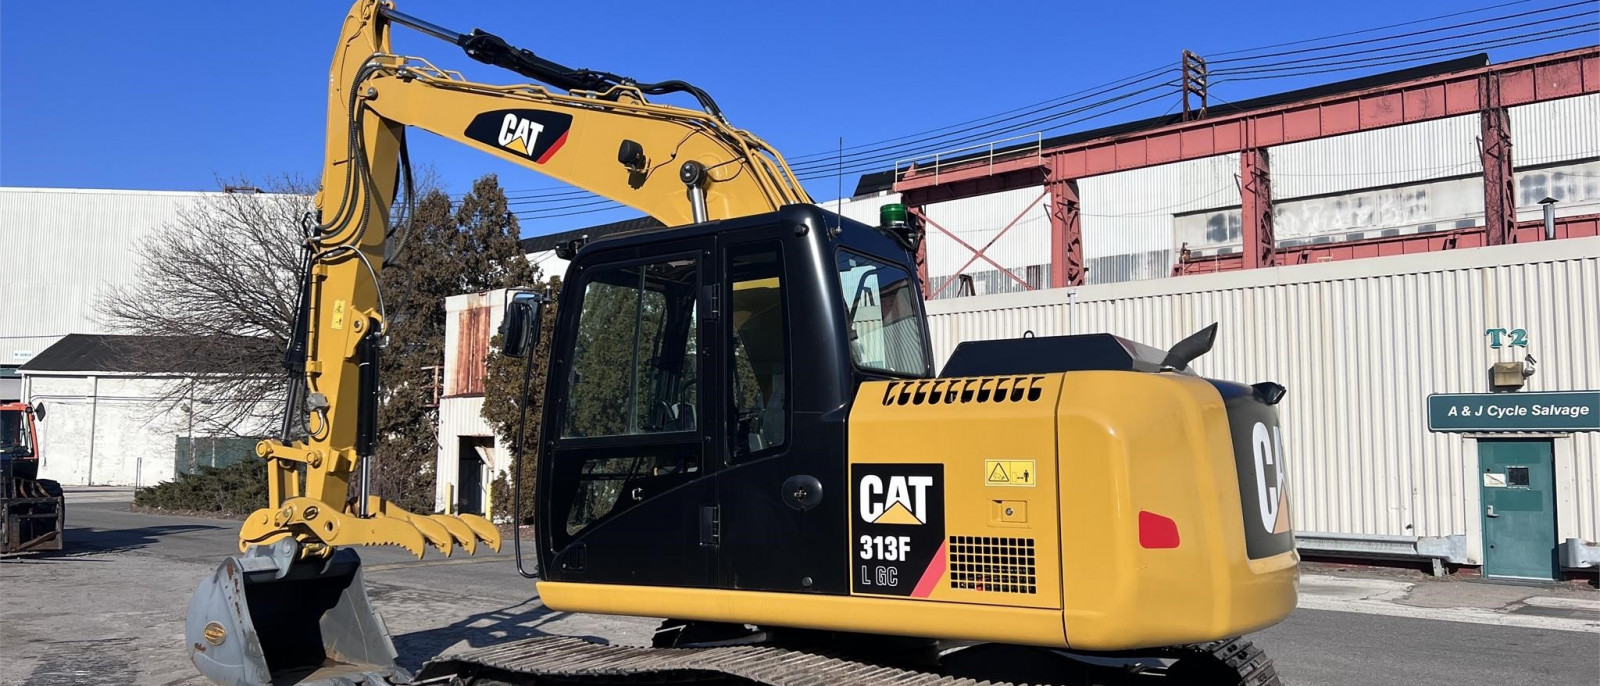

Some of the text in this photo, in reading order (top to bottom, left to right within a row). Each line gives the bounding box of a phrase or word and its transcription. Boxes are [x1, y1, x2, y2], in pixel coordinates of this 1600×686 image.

[498, 113, 544, 156] CAT
[1485, 328, 1528, 348] T2
[1447, 404, 1589, 418] A & J Cycle Salvage
[1252, 422, 1286, 534] CA
[860, 474, 933, 524] CAT
[860, 535, 911, 561] 313F
[861, 565, 898, 587] L GC
